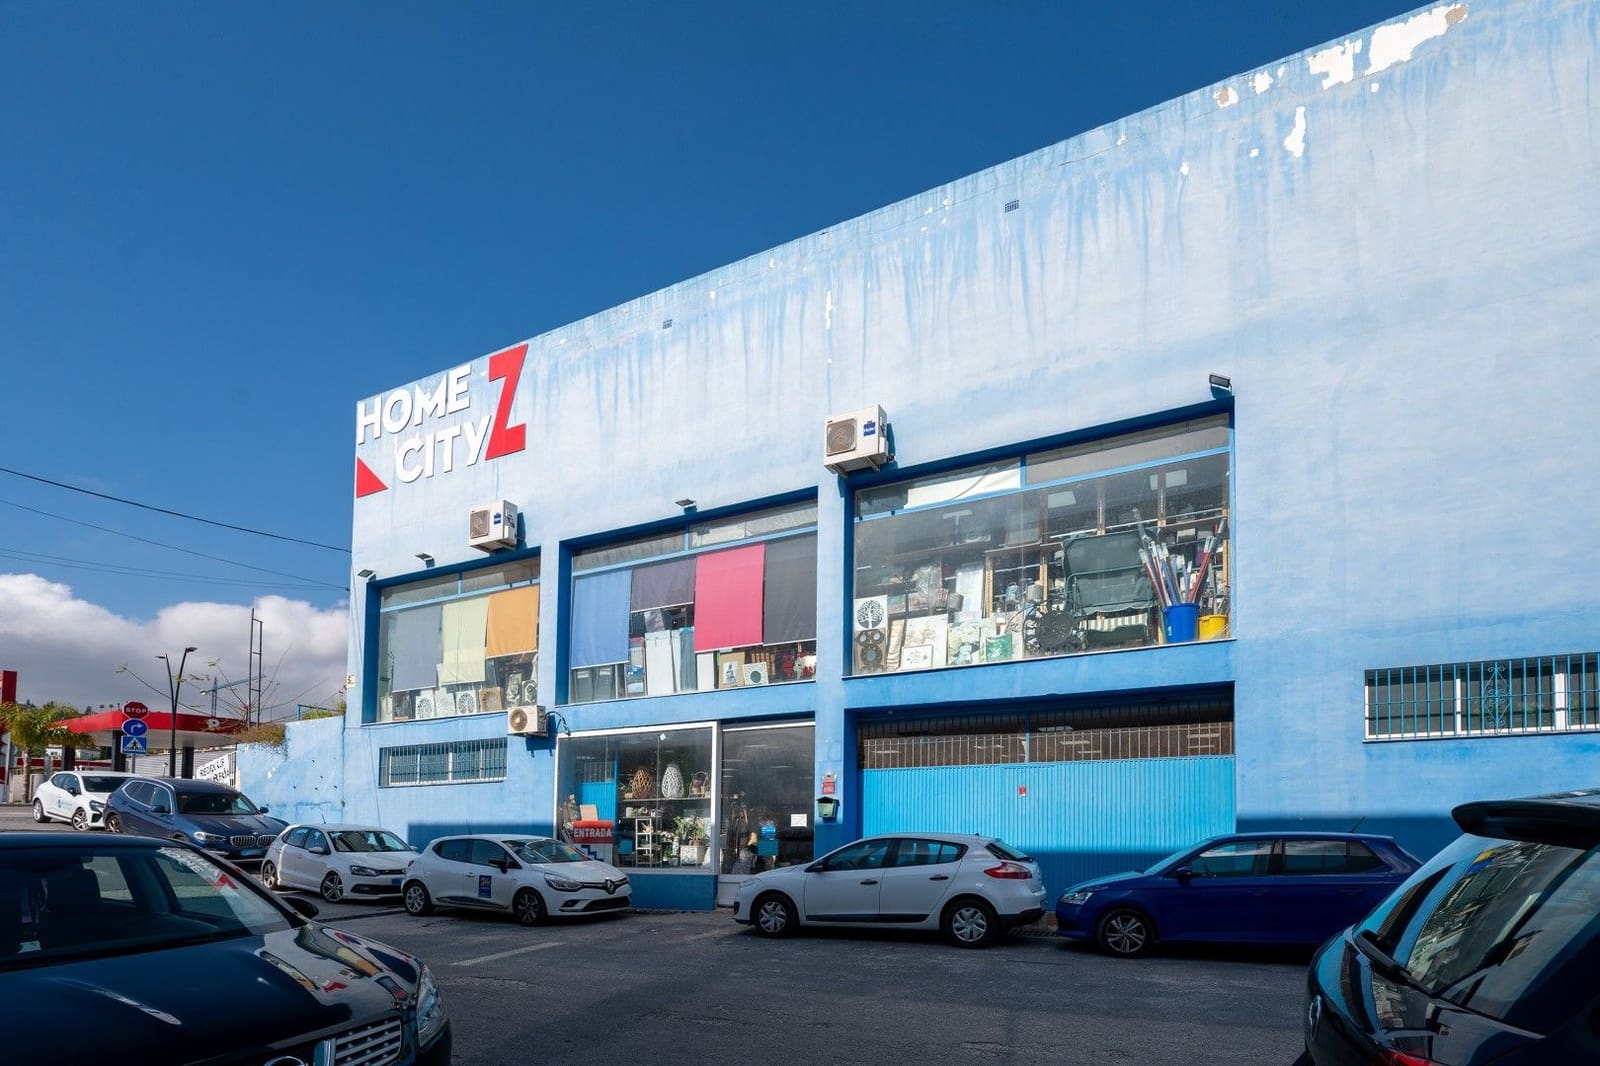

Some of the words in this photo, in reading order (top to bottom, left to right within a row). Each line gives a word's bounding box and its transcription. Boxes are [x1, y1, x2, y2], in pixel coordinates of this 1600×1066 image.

[356, 363, 472, 445] HOME
[396, 415, 491, 483] CITY
[573, 827, 612, 838] ENTRADA
